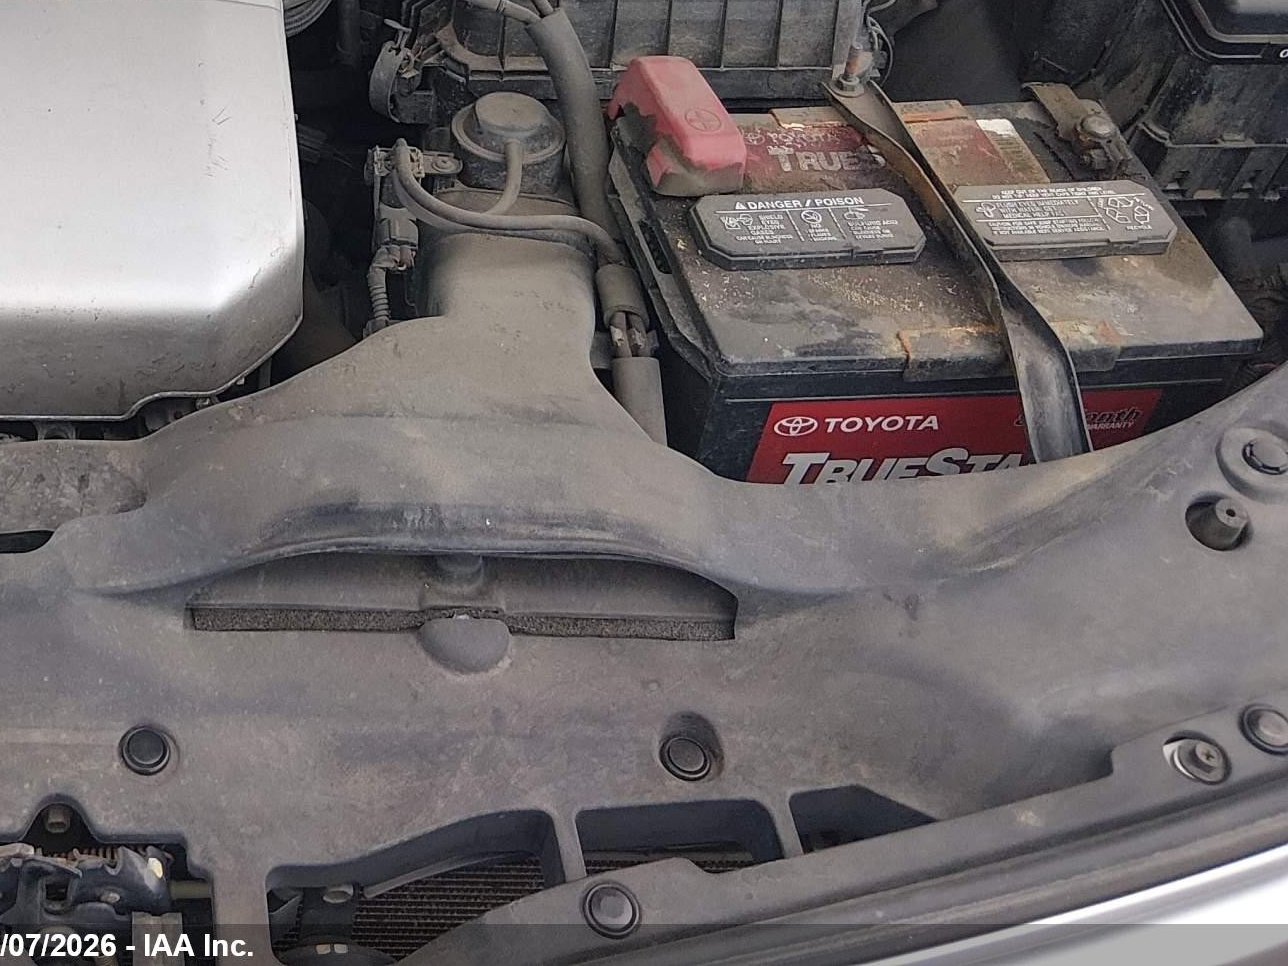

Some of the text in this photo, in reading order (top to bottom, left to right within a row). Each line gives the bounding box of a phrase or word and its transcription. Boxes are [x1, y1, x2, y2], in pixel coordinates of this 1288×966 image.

[747, 199, 803, 210] DANGER
[814, 196, 865, 206] POISON
[825, 415, 939, 433] TOYOTA
[1083, 406, 1144, 424] onth
